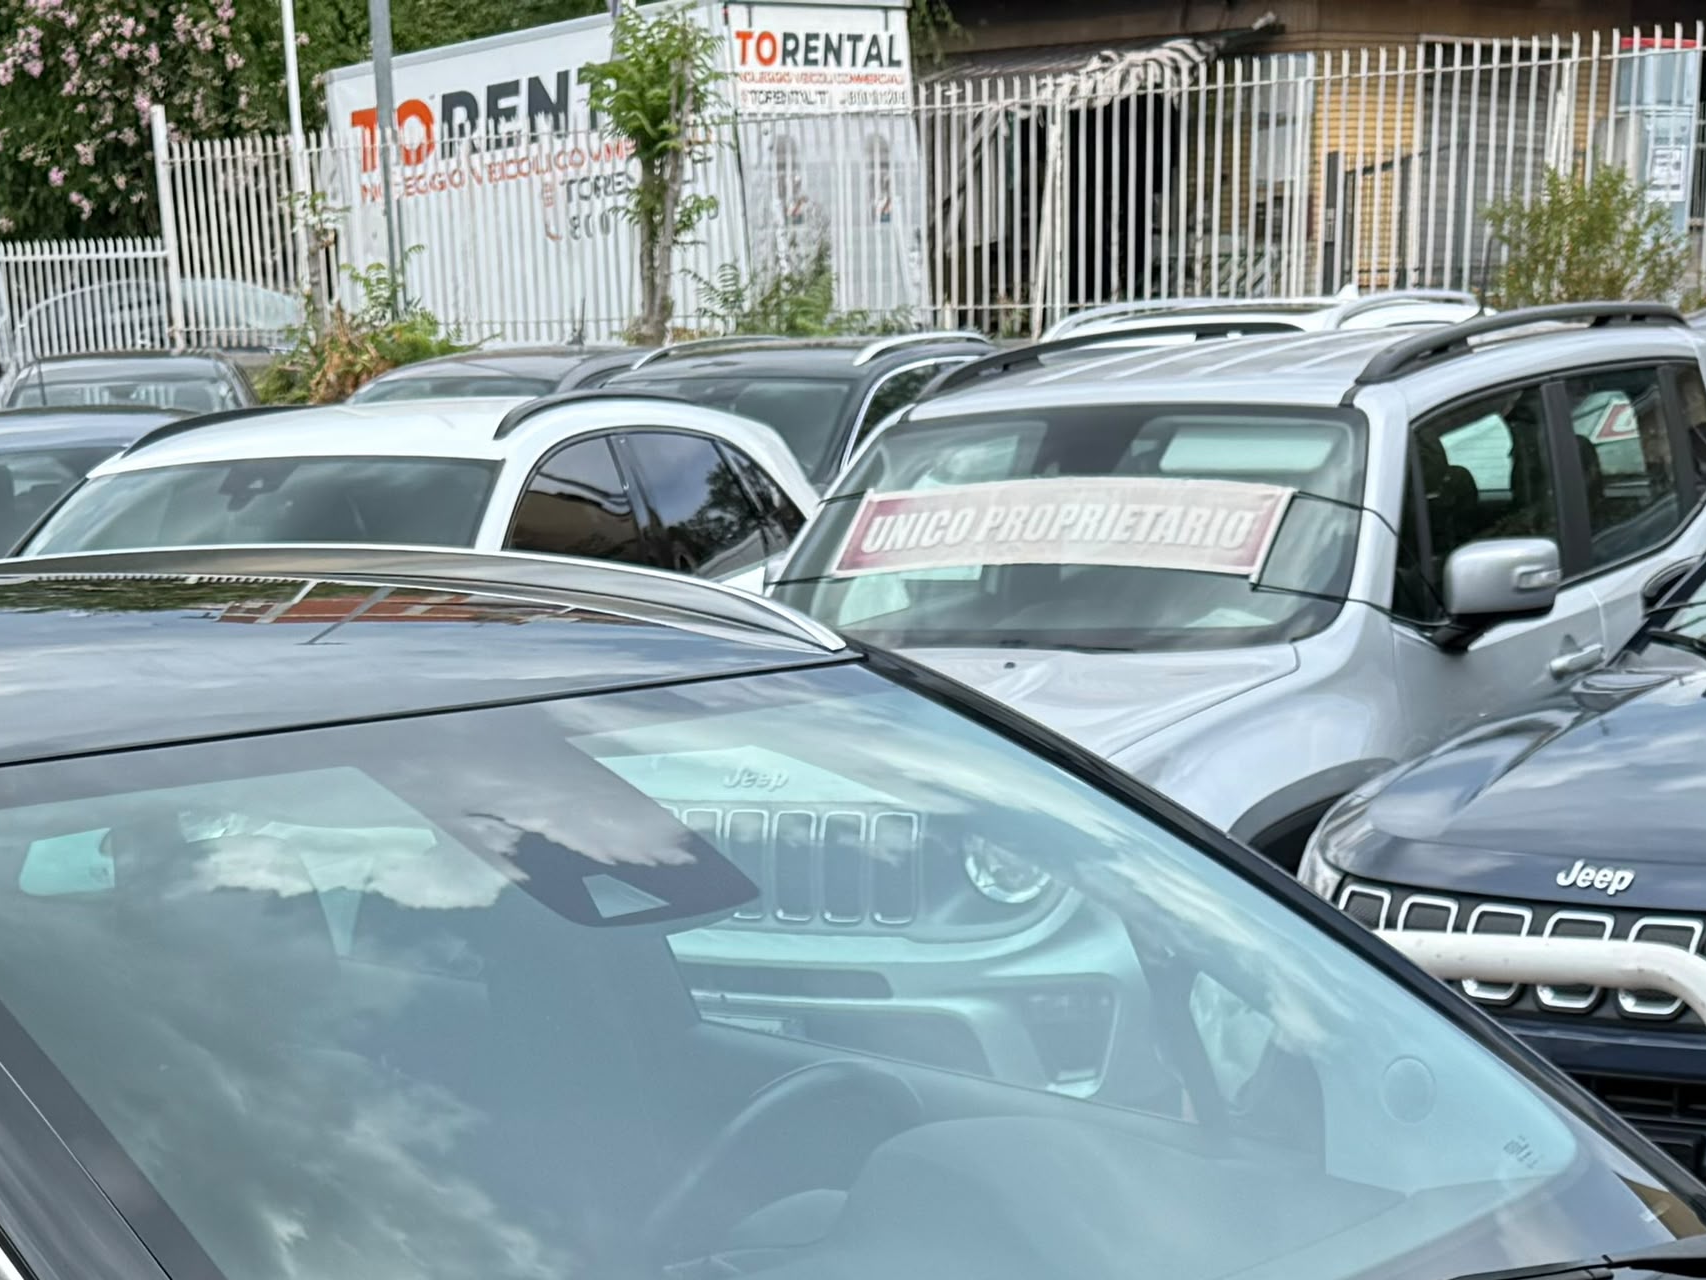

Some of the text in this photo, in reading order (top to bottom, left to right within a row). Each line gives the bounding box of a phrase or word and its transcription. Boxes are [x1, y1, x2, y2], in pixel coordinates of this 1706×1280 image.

[735, 31, 903, 68] TORENTAL
[861, 503, 1256, 554] UNICO PROPRIETARIO
[723, 765, 790, 793] Jeep
[1556, 858, 1636, 896] Jeep
